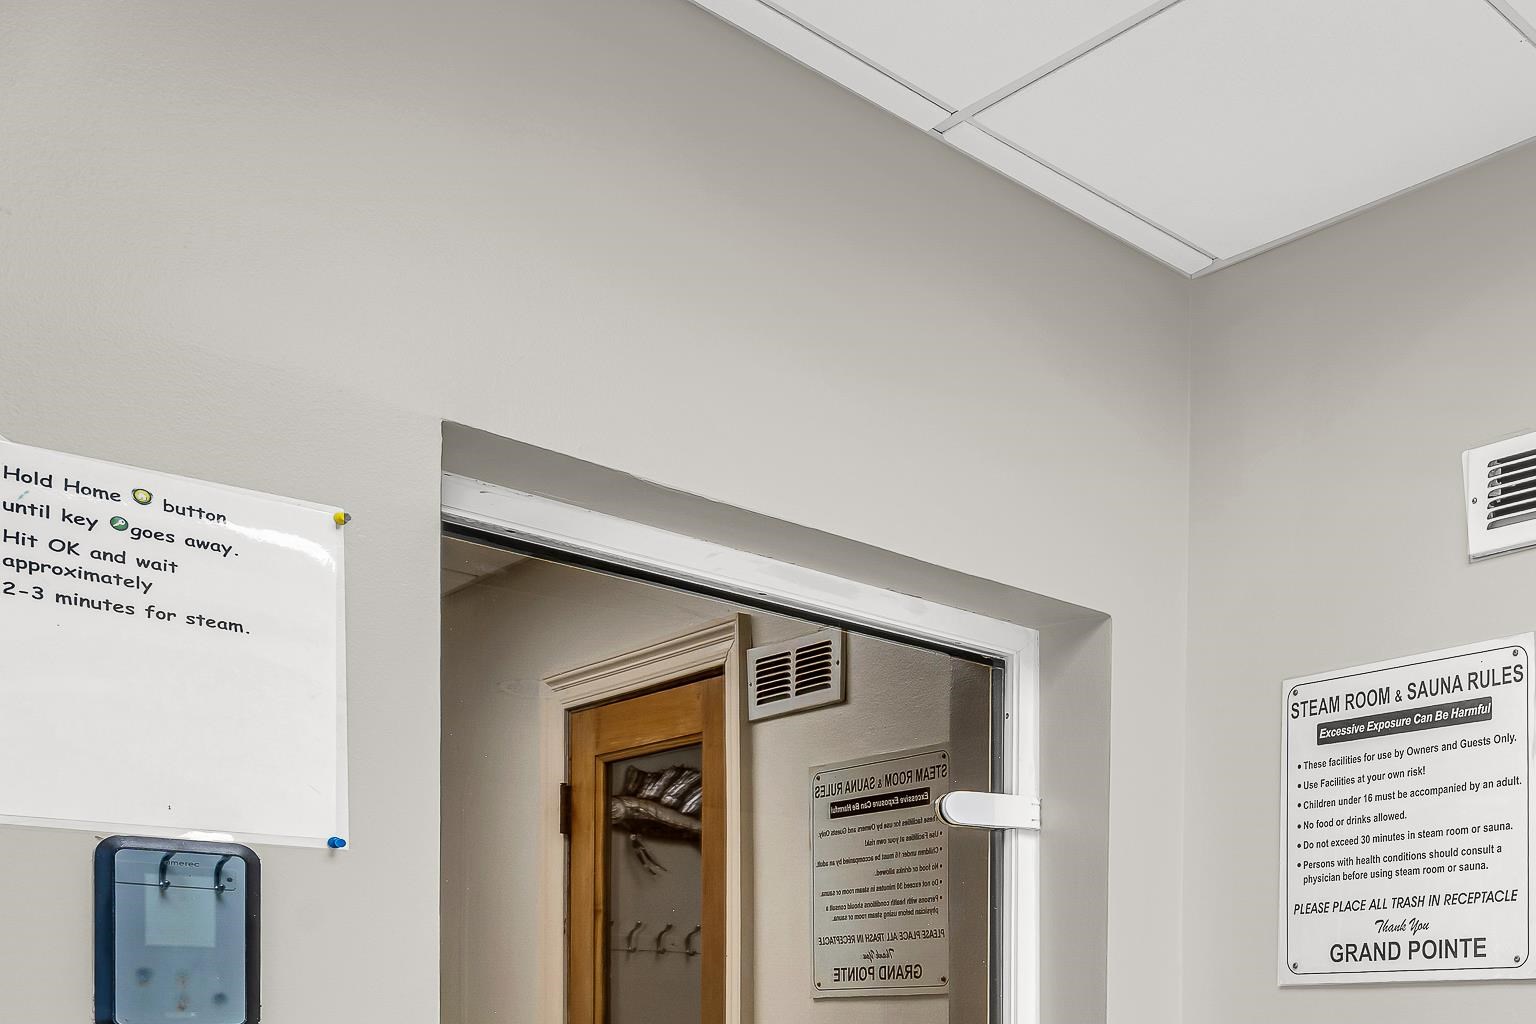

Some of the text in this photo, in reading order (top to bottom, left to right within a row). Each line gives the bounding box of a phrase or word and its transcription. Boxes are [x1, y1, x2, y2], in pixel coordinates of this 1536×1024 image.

[3, 465, 227, 523] Hold Home button
[2, 501, 238, 557] until key goes away.
[3, 529, 178, 574] Hit OK and wait
[2, 555, 152, 594] approximately
[2, 582, 249, 634] 2-3 minutes for steam.
[1291, 664, 1523, 719] STEAM ROOM & SAUNA RULES
[1319, 702, 1491, 739] Excessive Exposure Can Be Harmful
[1303, 733, 1517, 770] These facilities for use by Owners and Guests Only.
[1303, 766, 1426, 790] Use Facilities at your own risk!
[1303, 776, 1522, 810] Children under 16 must be accompanied by an adult.
[1303, 810, 1407, 830] No food or drinks allowed.
[1303, 822, 1513, 850] Do not exceed 30 minutes in steam room or sauna.
[1303, 844, 1502, 870] Persons with health conditions should consult a
[1303, 862, 1489, 886] physician before using steam room or sauna.
[1293, 889, 1518, 915] PLEASE PLACE ALL TRASH IN RECEPTACLE
[1374, 917, 1430, 935] Thank You
[1330, 937, 1487, 963] GRAND POINTE
